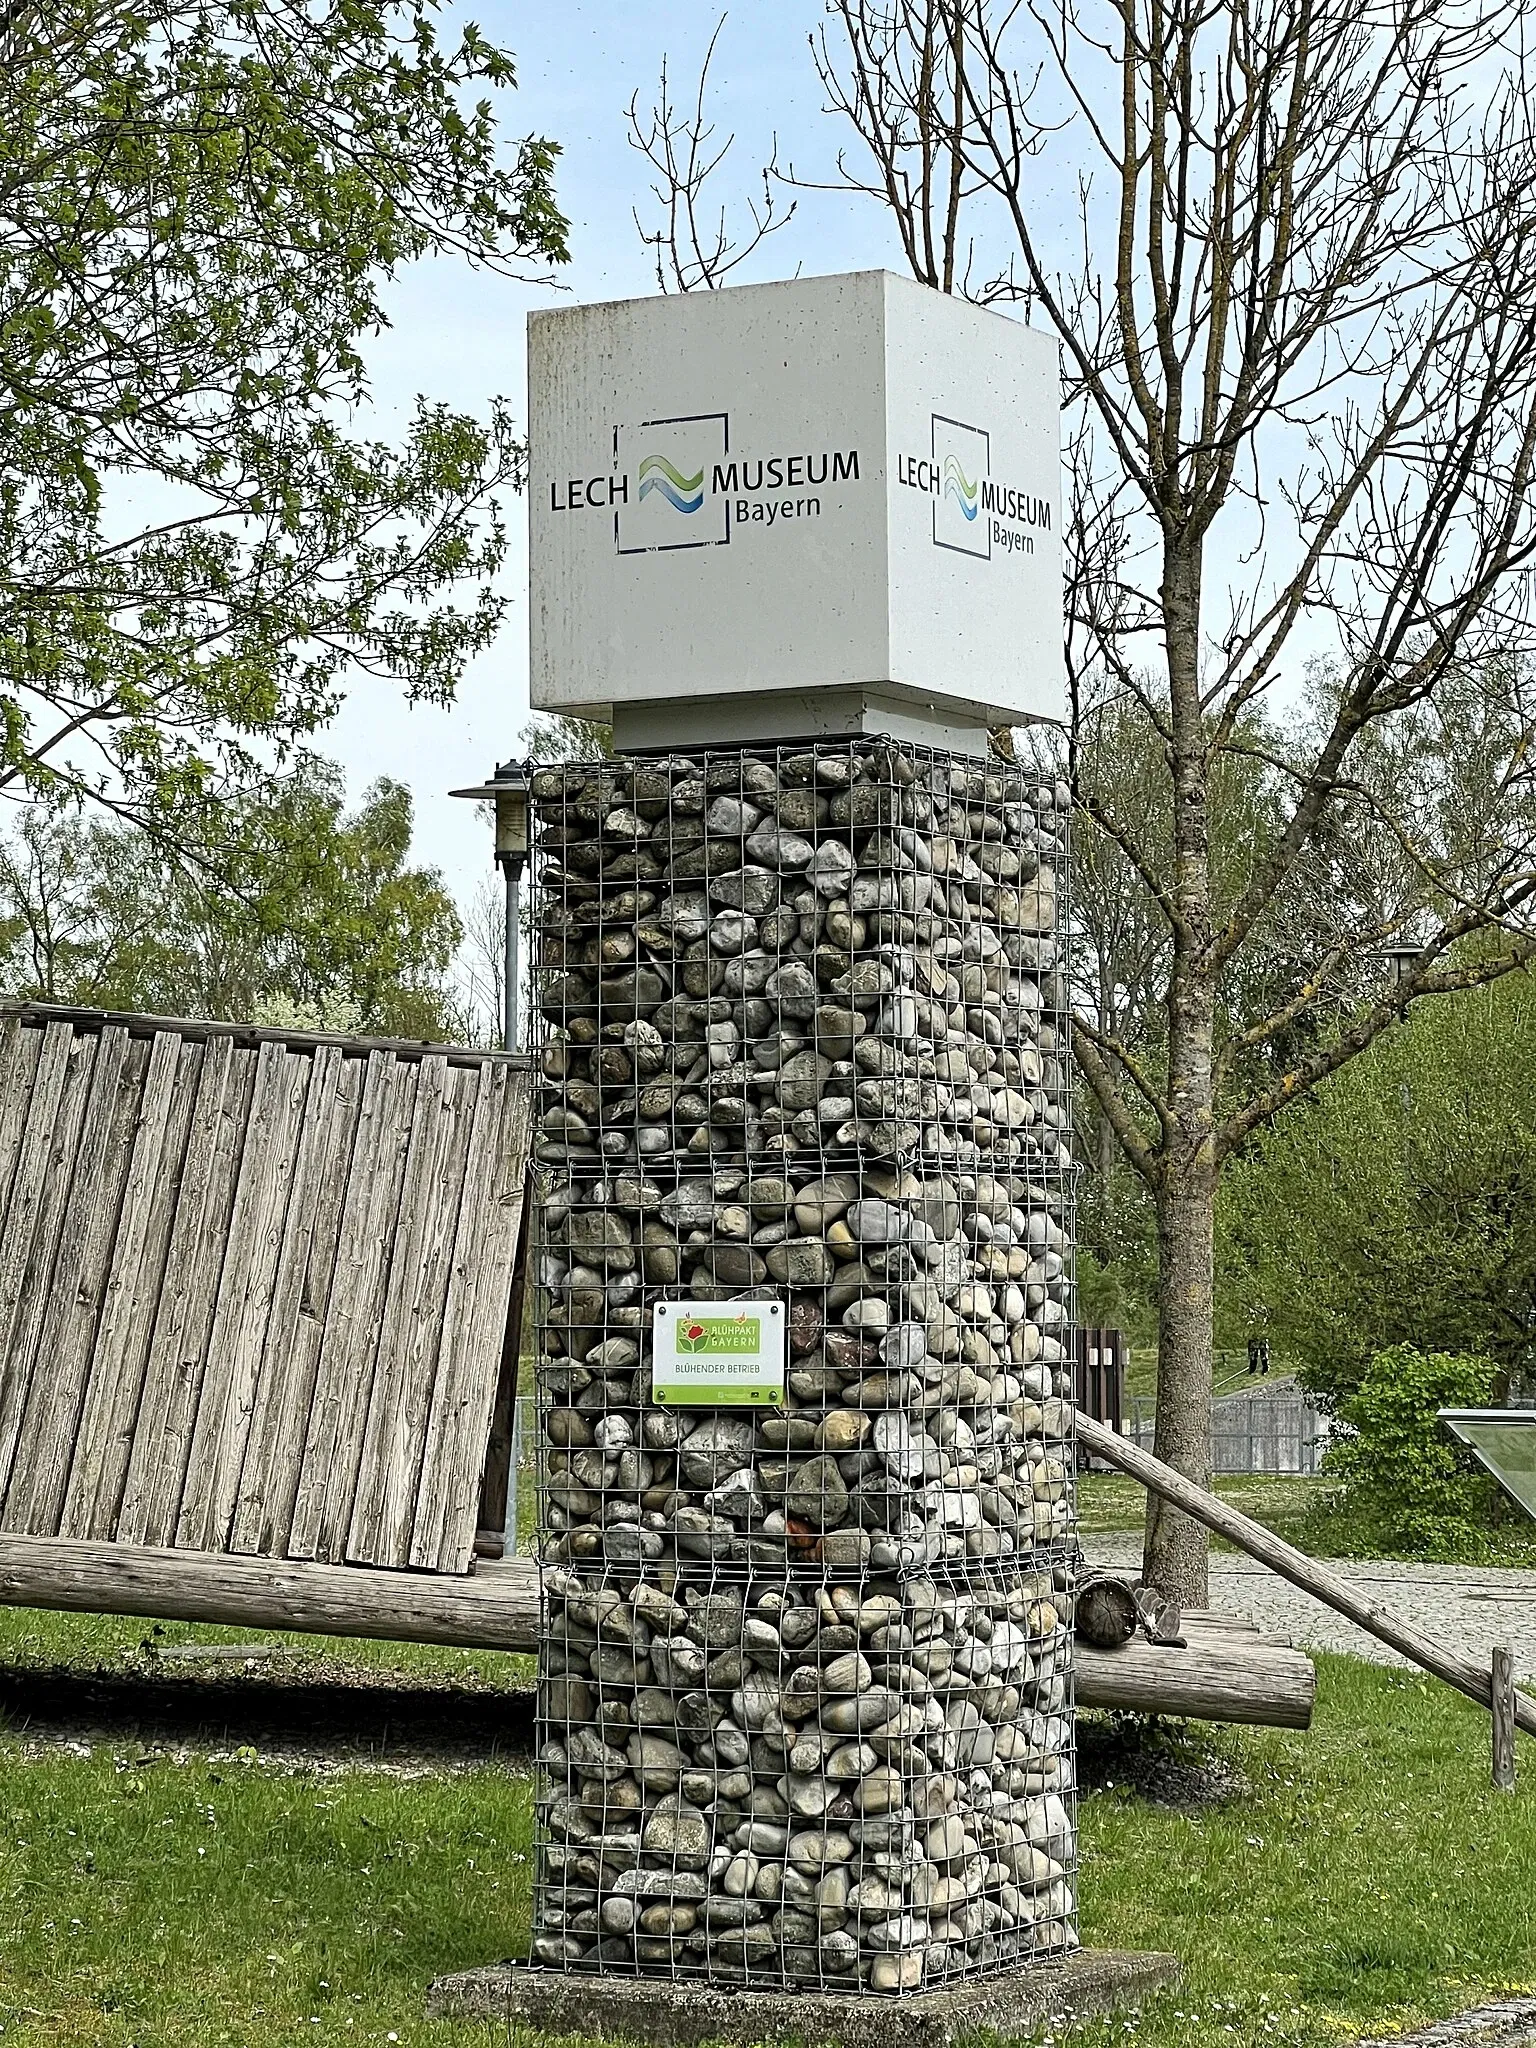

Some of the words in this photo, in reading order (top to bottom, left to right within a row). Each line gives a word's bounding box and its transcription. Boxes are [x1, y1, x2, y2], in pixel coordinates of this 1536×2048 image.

[550, 474, 629, 512] LECH
[711, 450, 861, 495] MUSEUM
[898, 453, 941, 496] LECH
[981, 480, 1052, 532] MUSEUM
[735, 496, 821, 526] Bayern
[993, 520, 1034, 555] Bayern
[711, 1325, 756, 1335] BLÜHPAKT
[711, 1337, 756, 1346] BAYERN
[675, 1363, 725, 1373] BLÜHENDER
[727, 1364, 760, 1373] BETRIEB
